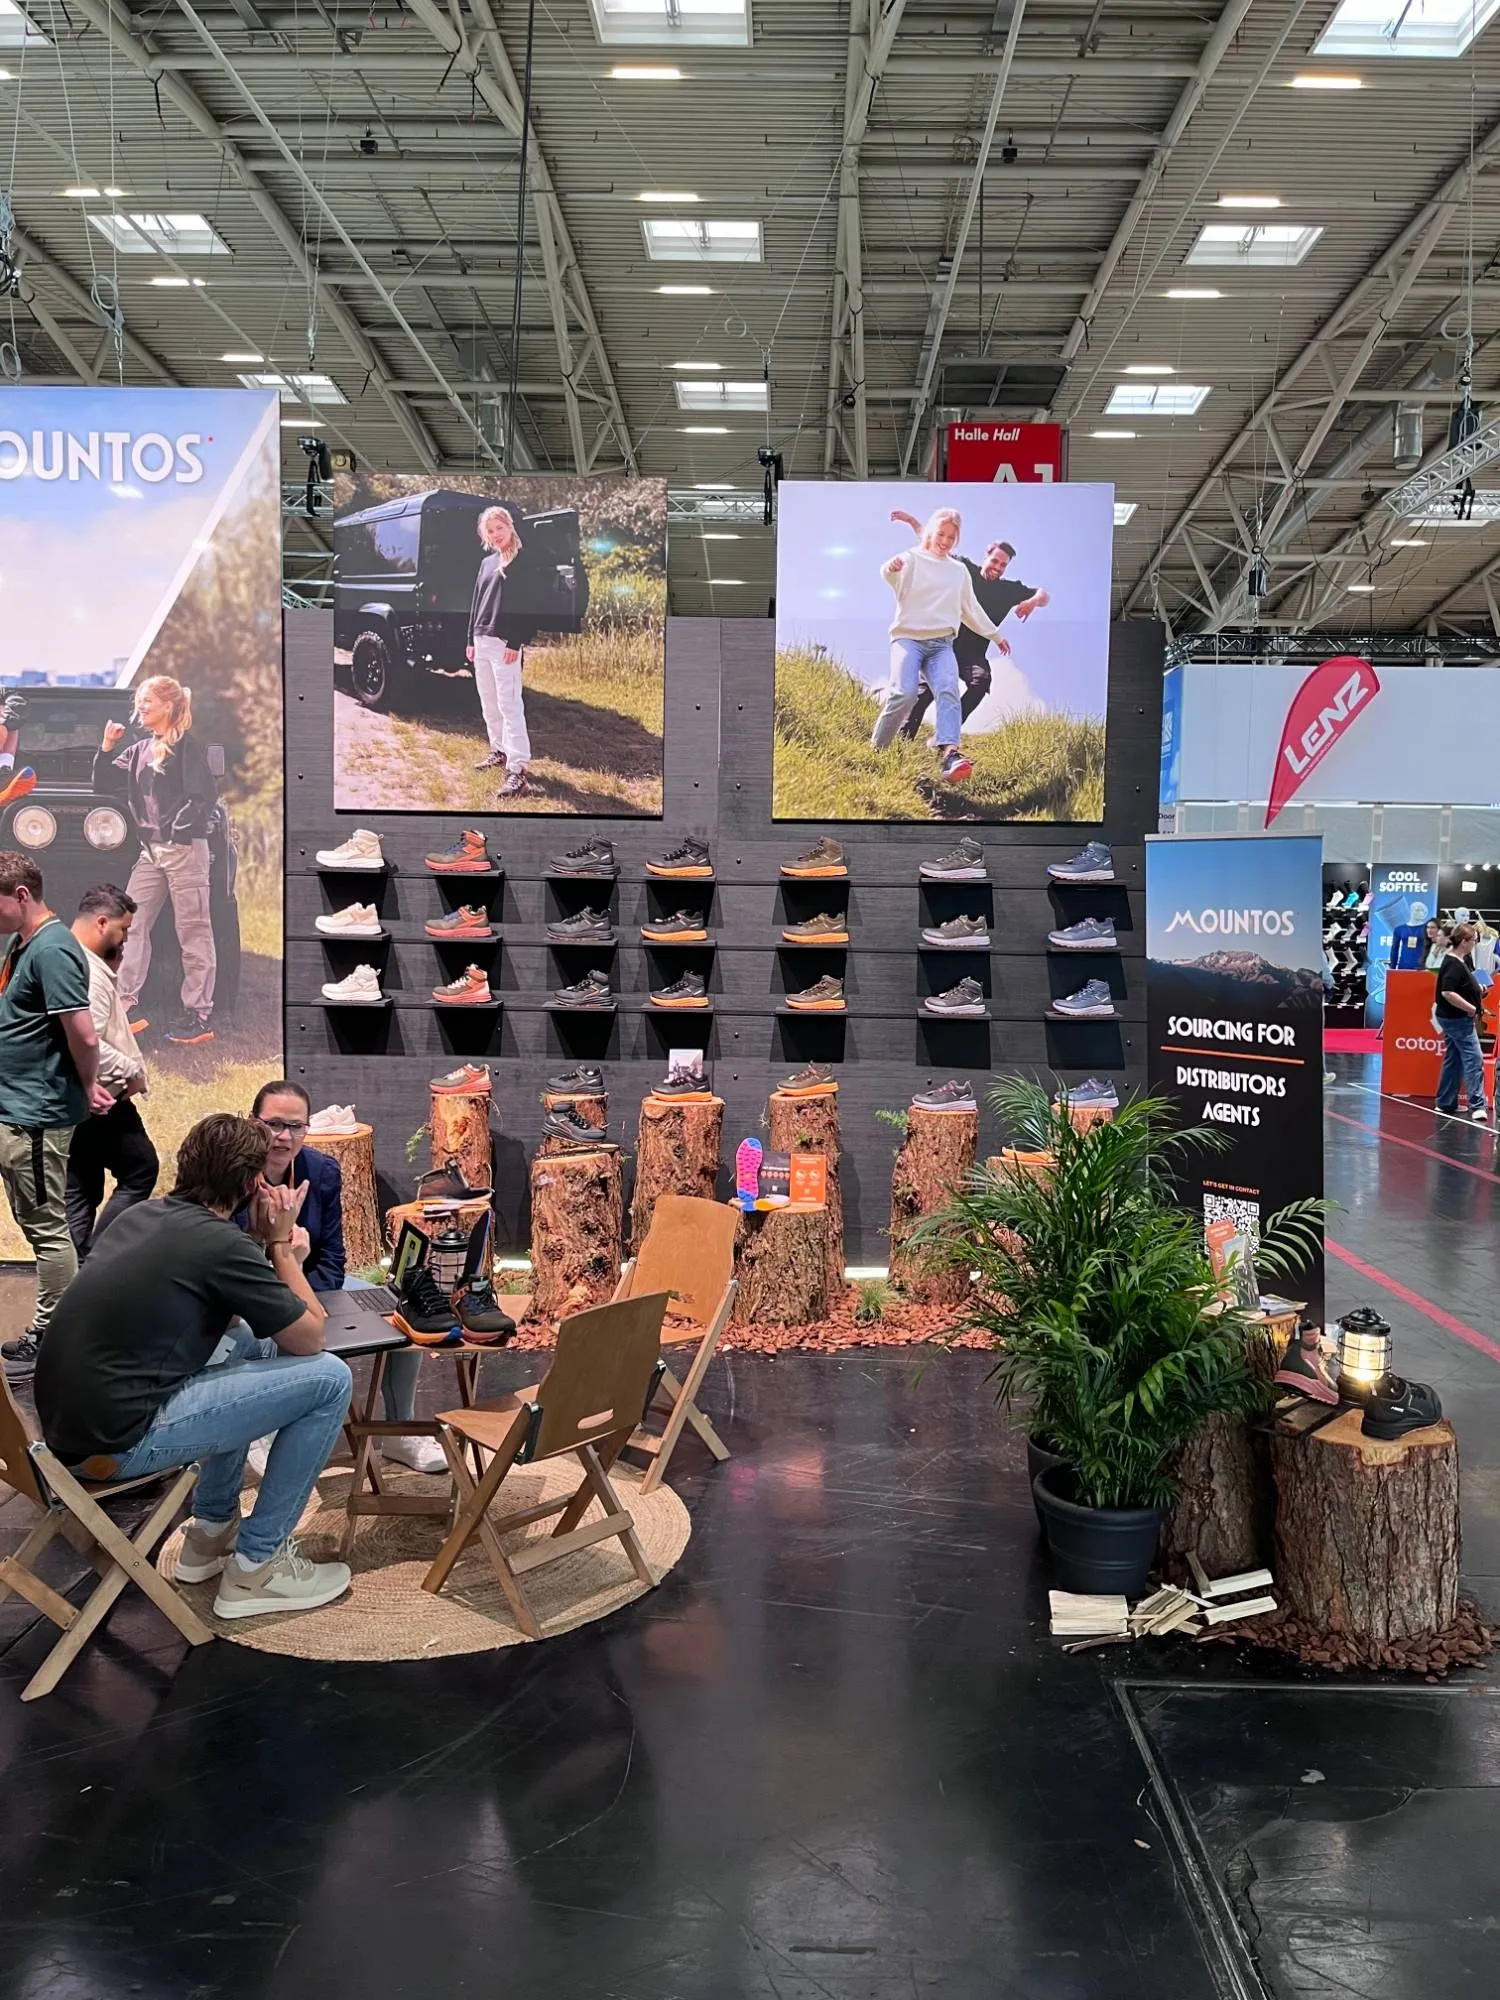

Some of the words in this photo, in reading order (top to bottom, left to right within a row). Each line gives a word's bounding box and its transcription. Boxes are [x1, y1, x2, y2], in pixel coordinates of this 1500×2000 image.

[954, 428, 989, 441] Halle
[992, 428, 1020, 441] Hall
[1284, 670, 1369, 775] LENZ
[1379, 882, 1428, 892] SOFTTEC
[1388, 871, 1420, 882] COOL
[1165, 909, 1295, 936] MOUNTOS
[1167, 1016, 1253, 1042] SOURCING
[1258, 1024, 1296, 1046] FOR
[1176, 1066, 1286, 1097] DISTRIBUTORS
[1202, 1101, 1260, 1127] AGENTS
[1235, 1186, 1260, 1195] CONTACT
